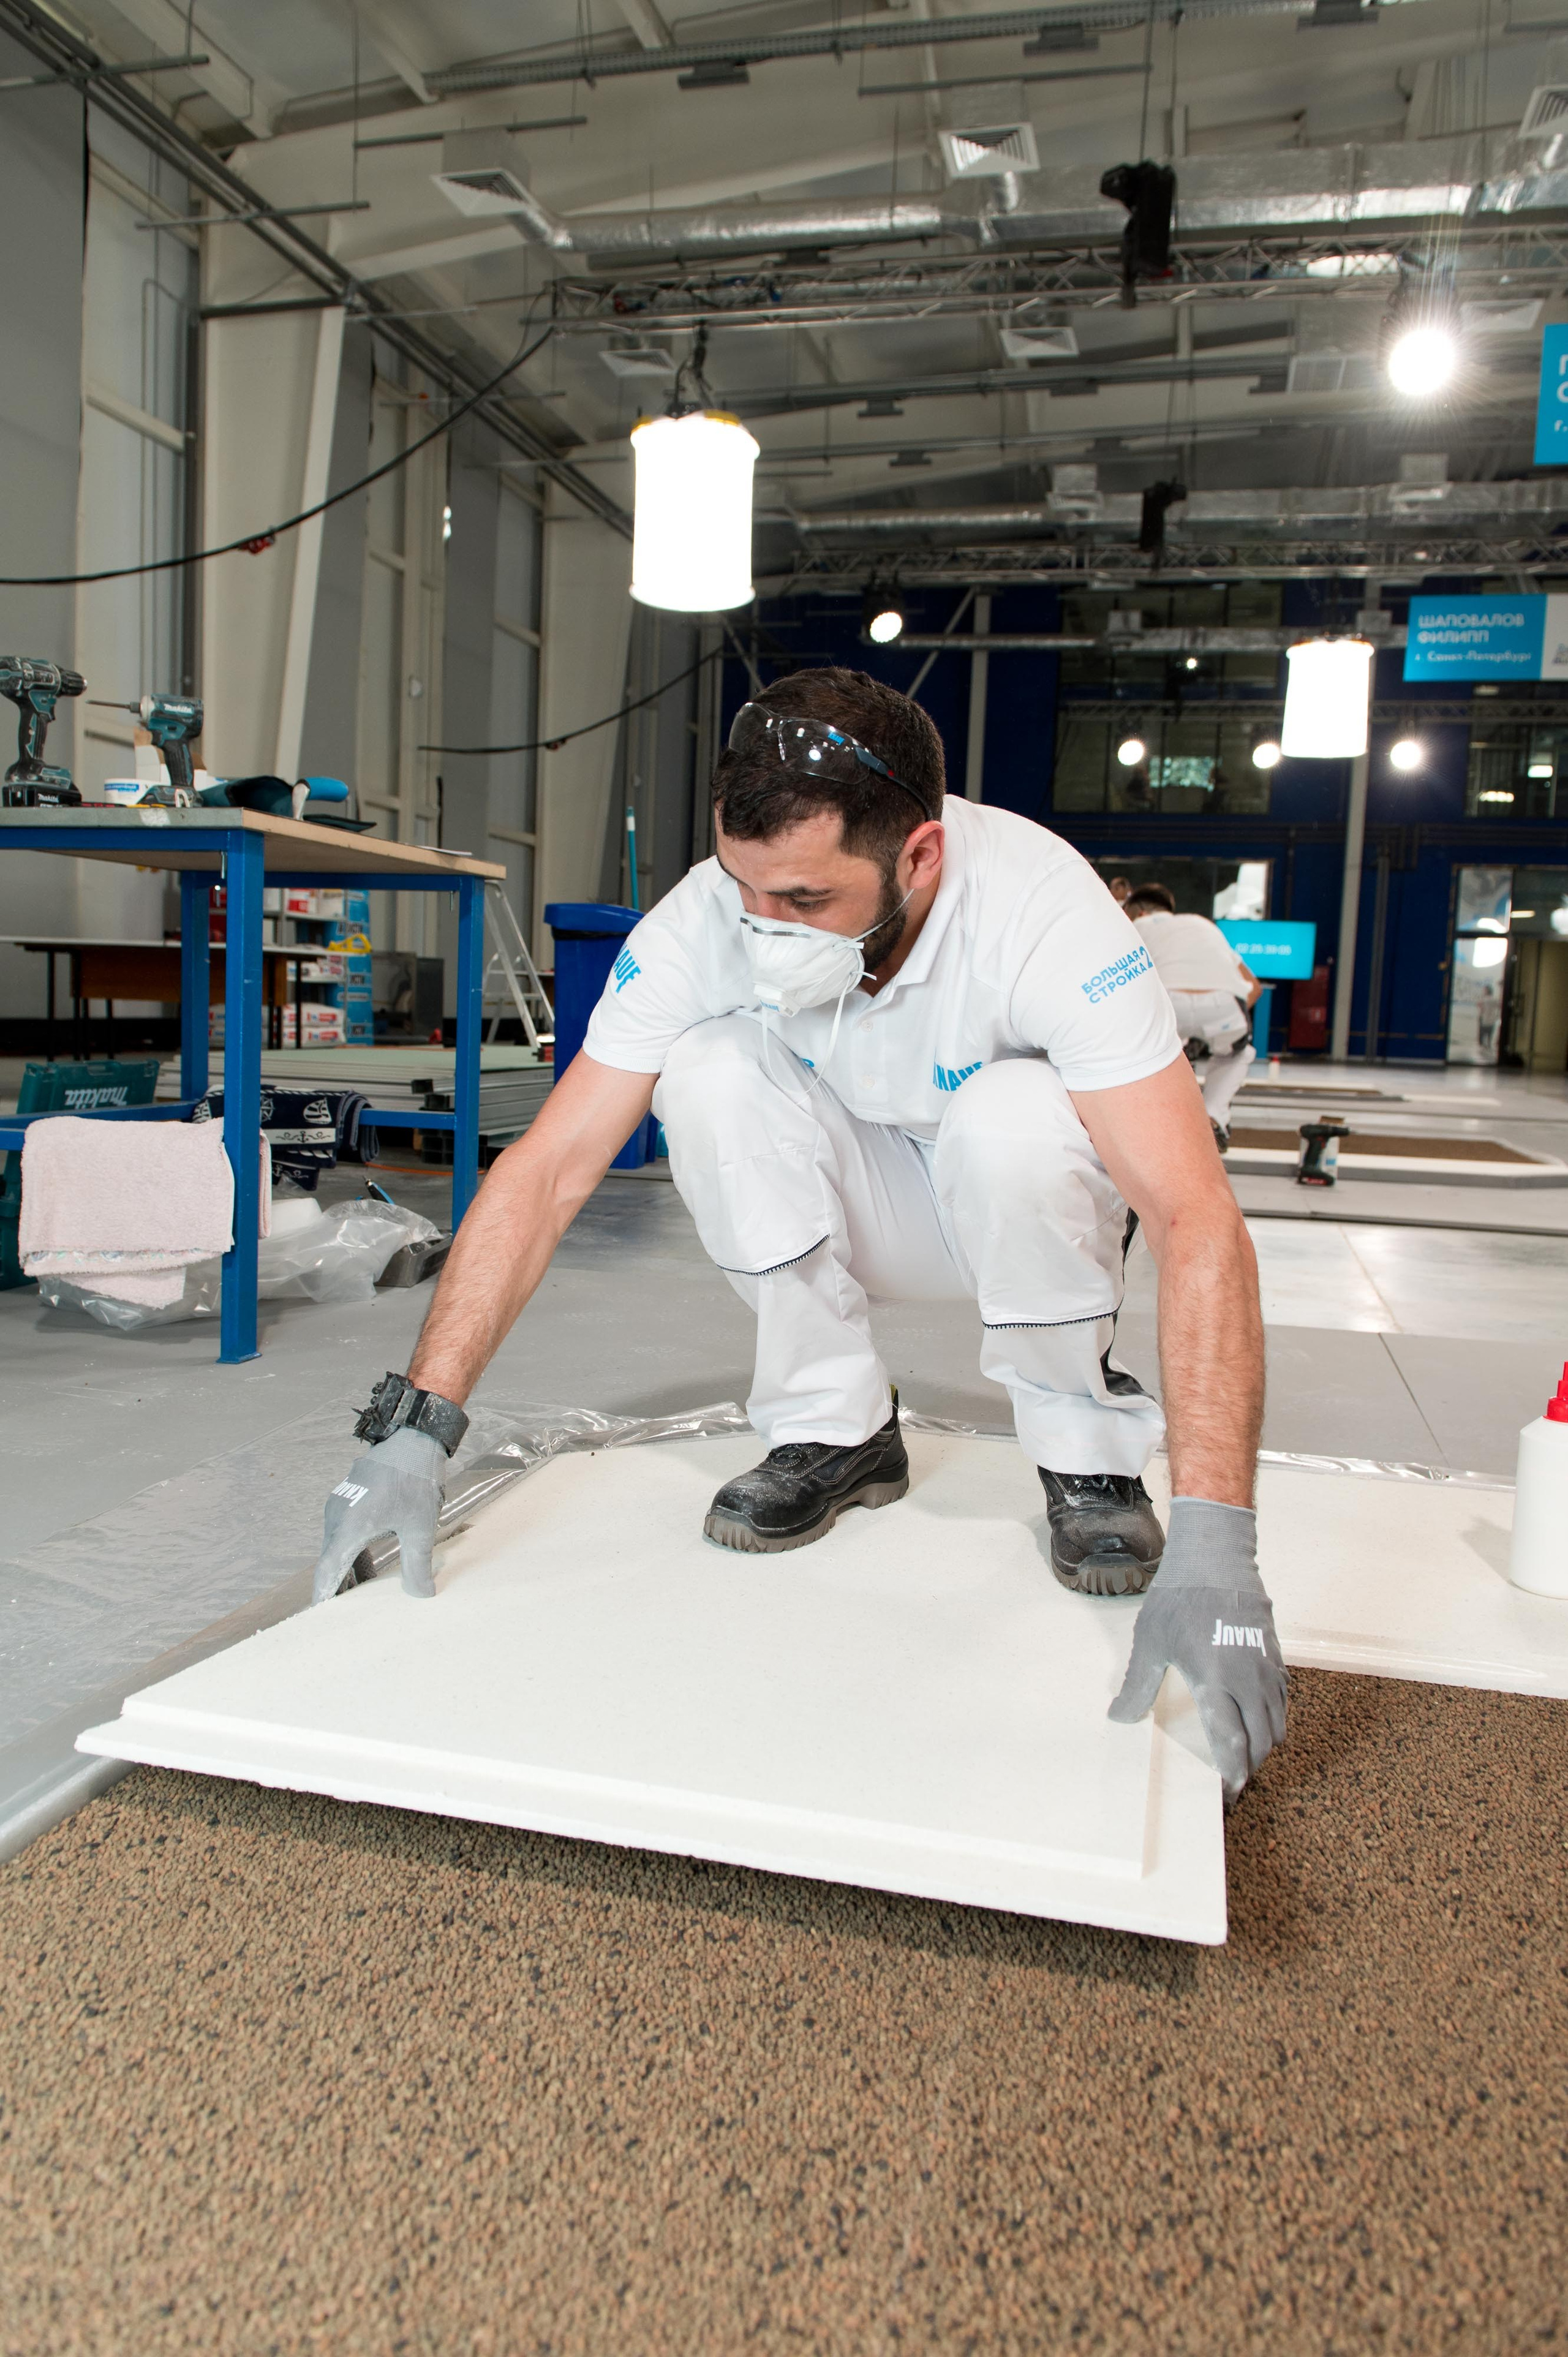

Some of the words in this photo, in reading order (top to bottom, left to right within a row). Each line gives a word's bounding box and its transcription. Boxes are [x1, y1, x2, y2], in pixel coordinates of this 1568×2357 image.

[1416, 630, 1490, 644] ФИЛИПП
[1417, 613, 1525, 628] ШАПОВАЛОВ
[612, 941, 642, 994] AUF
[1080, 949, 1141, 995] БОЛЬШАЯ
[1088, 962, 1147, 1004] СТРОЙКА
[1211, 1618, 1267, 1657] KNAUF
